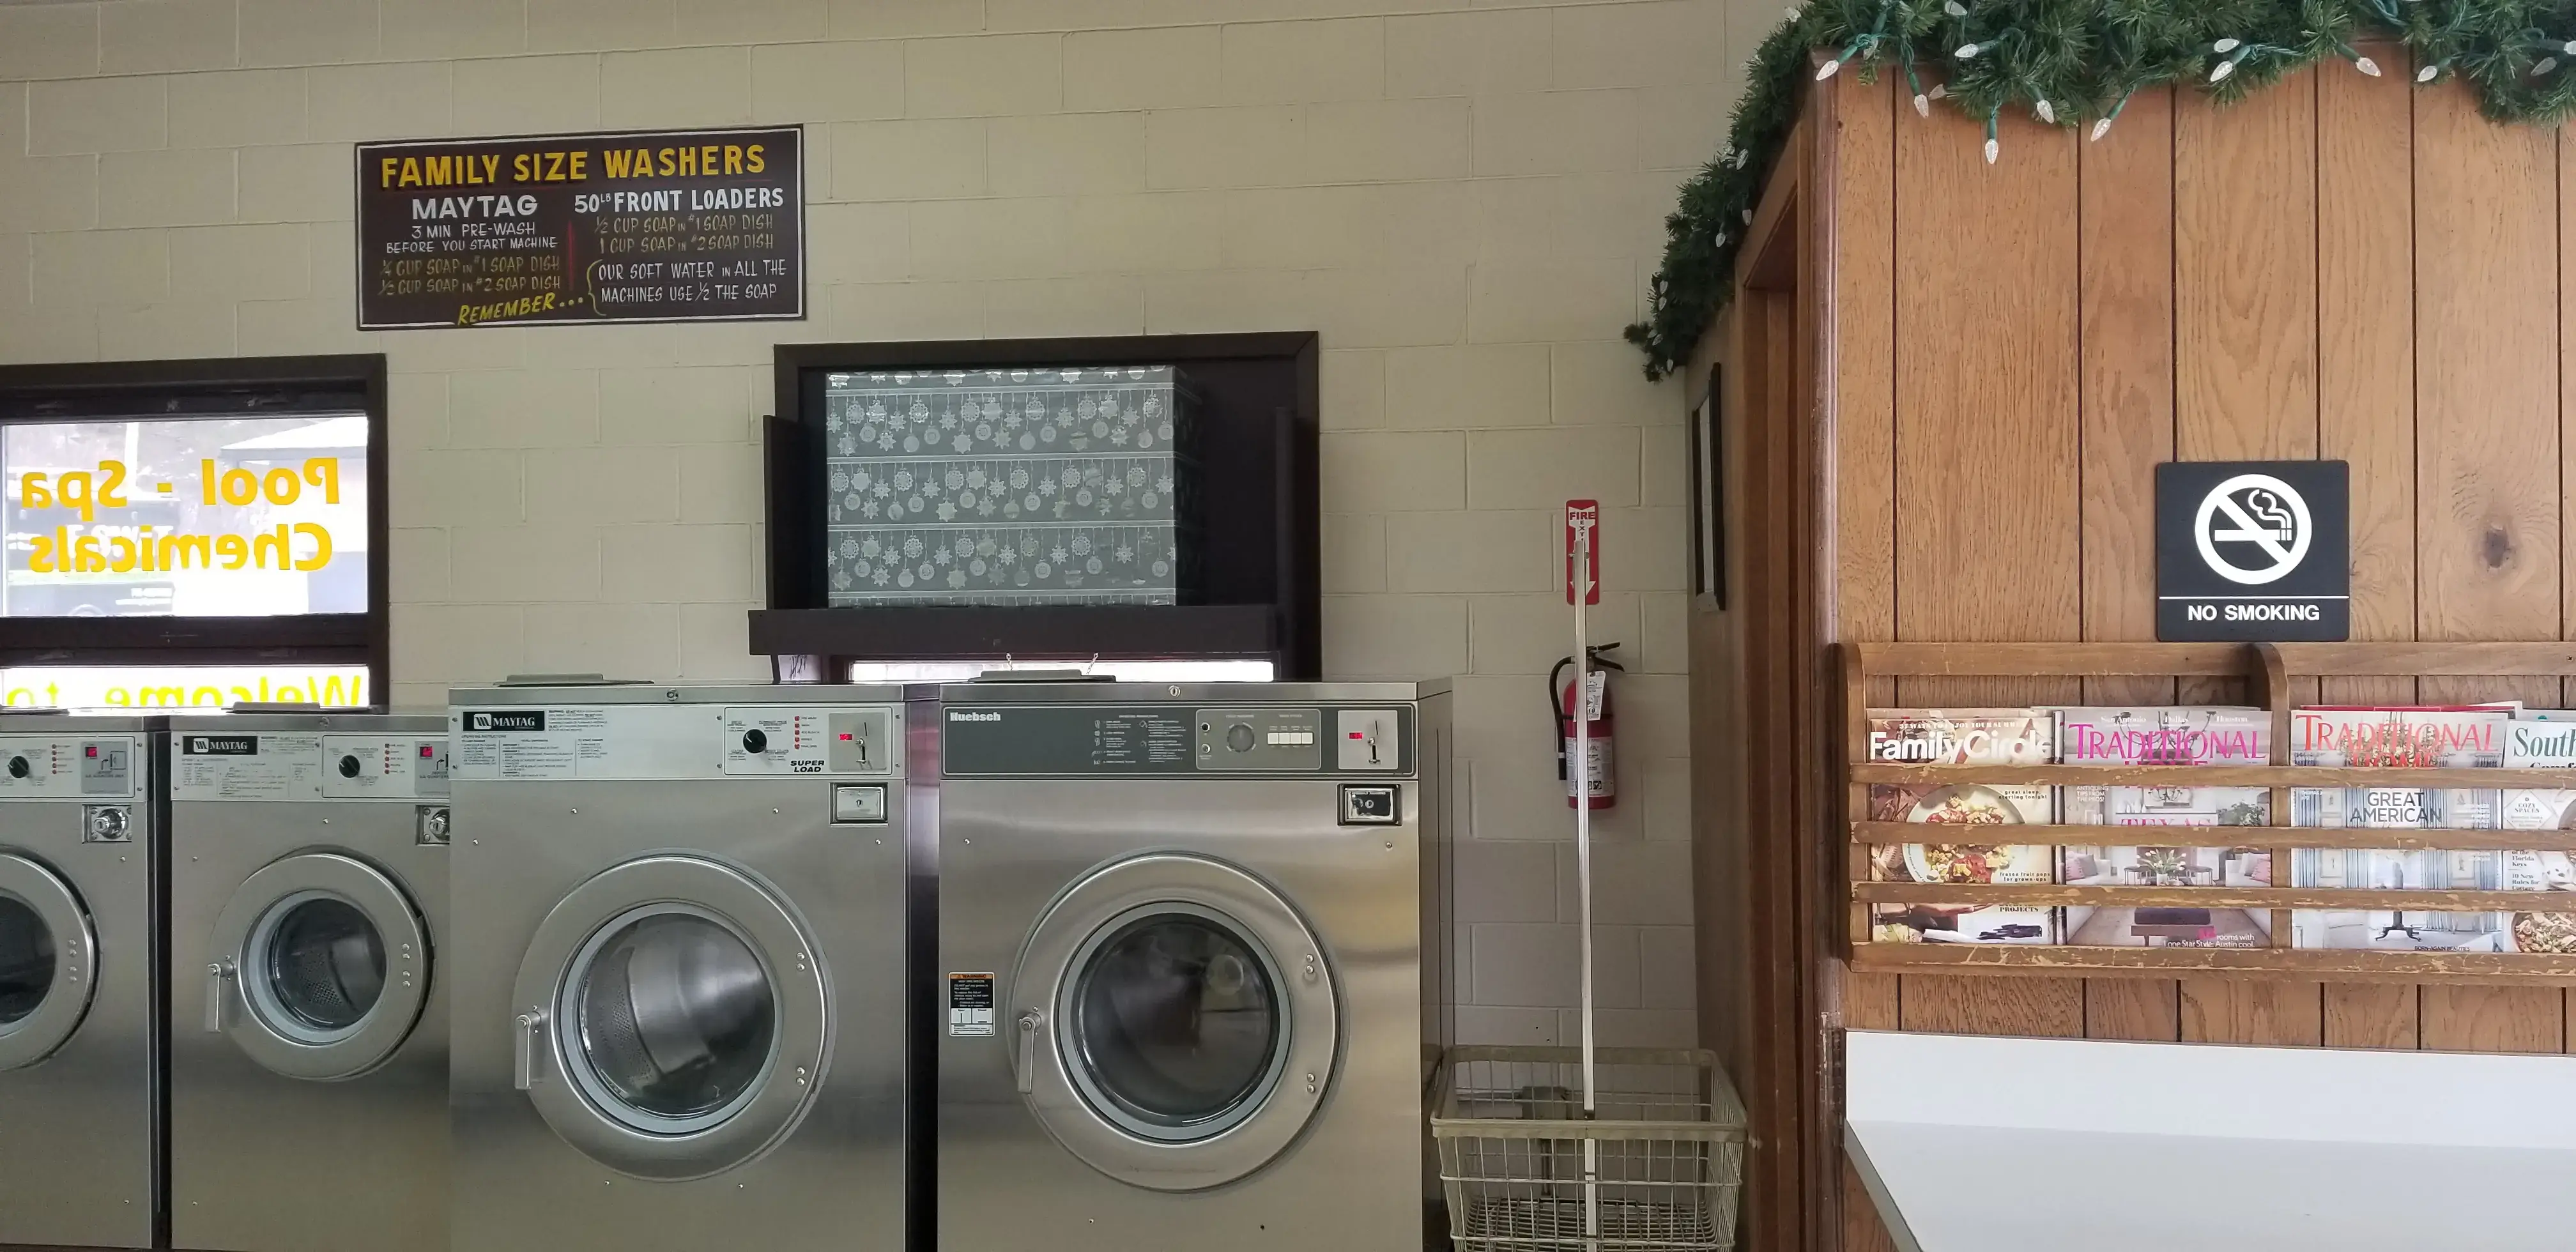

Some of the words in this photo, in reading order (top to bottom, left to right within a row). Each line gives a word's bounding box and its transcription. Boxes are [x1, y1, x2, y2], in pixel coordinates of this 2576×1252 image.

[381, 155, 500, 188] FAMILY
[514, 151, 588, 181] SIZE
[604, 144, 765, 179] WASHERS
[412, 195, 539, 220] MAYTAG
[614, 190, 682, 213] FRONT
[691, 187, 784, 211] LOADERS
[411, 225, 422, 239] 3
[427, 224, 451, 238] MIN
[462, 222, 535, 236] PRE-WASH
[613, 217, 639, 233] CUP
[643, 217, 676, 233] SOAP
[678, 222, 686, 231] IN
[703, 215, 736, 231] SOAP
[742, 214, 773, 230] DISH
[387, 241, 434, 254] BEFORE
[442, 240, 465, 252] YOU
[470, 238, 505, 250] START
[510, 236, 559, 249] MACHINE
[599, 238, 604, 254] 1
[610, 238, 634, 253] CUP
[641, 236, 676, 253] SOAP
[678, 242, 686, 251] IN
[708, 234, 740, 250] SOAP
[744, 233, 774, 249] DISH
[396, 259, 422, 276] CUP
[426, 258, 460, 275] SOAP
[463, 264, 472, 273] IN
[491, 256, 524, 272] SOAP
[531, 255, 560, 271] DISH
[598, 263, 624, 280] OUR
[630, 262, 663, 279] SOFT
[671, 261, 715, 279] WATER
[722, 266, 730, 277] IN
[734, 260, 758, 277] ALL
[763, 259, 787, 277] THE
[398, 279, 421, 294] CUP
[427, 278, 459, 293] SOAP
[463, 283, 473, 293] IN
[496, 277, 526, 291] SOAP
[532, 275, 560, 291] DISH
[601, 286, 663, 303] MACHINES
[670, 286, 693, 302] USE
[715, 284, 739, 300] THE
[745, 283, 777, 299] SOAP
[1569, 512, 1596, 521] FIRE
[2188, 604, 2218, 621] NO
[2225, 604, 2320, 621] SMOKING
[493, 717, 535, 727] MAYTAG
[950, 712, 1001, 722] Huebsch
[2068, 723, 2267, 760] TRADITIONAL
[2295, 714, 2499, 752] TRADITIONAL
[210, 741, 248, 751] MAYTAG
[2367, 792, 2425, 807] GREAT
[2350, 807, 2442, 823] AMERICAN
